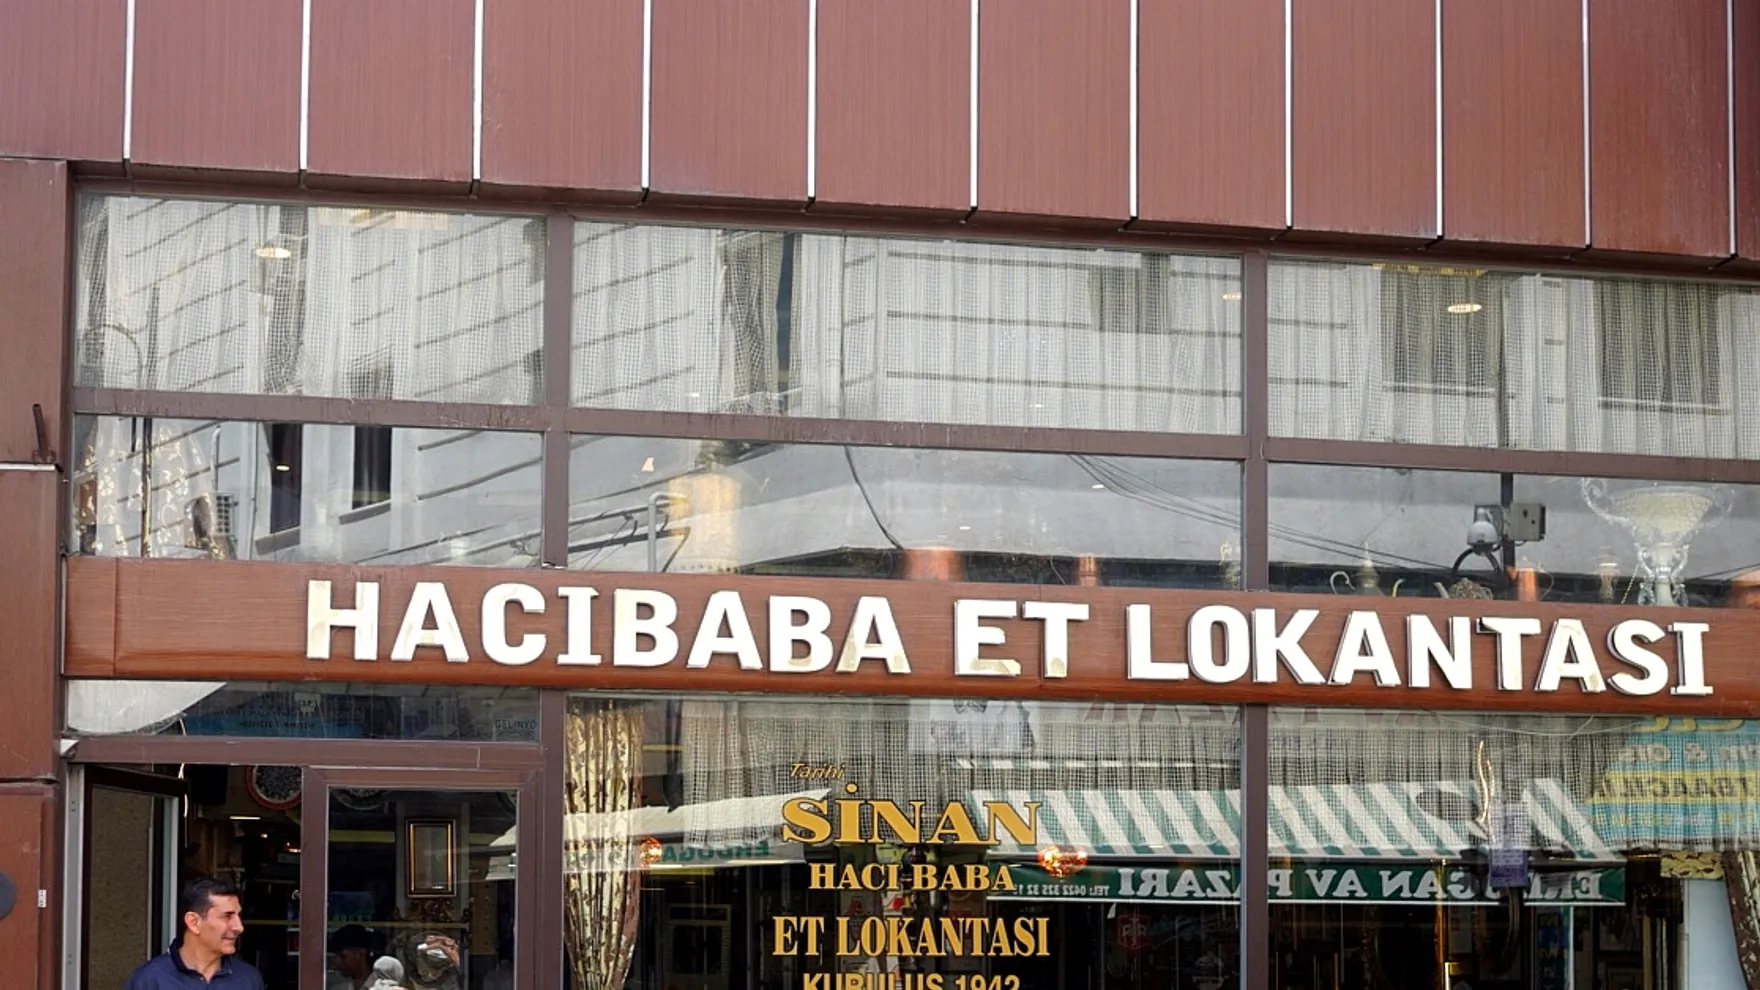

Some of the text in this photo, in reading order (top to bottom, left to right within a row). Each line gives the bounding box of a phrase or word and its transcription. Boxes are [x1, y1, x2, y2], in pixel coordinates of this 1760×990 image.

[306, 579, 1713, 697] HACIBABA ET LOKANTASI
[789, 763, 846, 781] Tarihi
[809, 863, 1017, 892] HACI BABA
[773, 916, 1051, 957] ET LOKANTASI
[956, 973, 1021, 990] 1942
